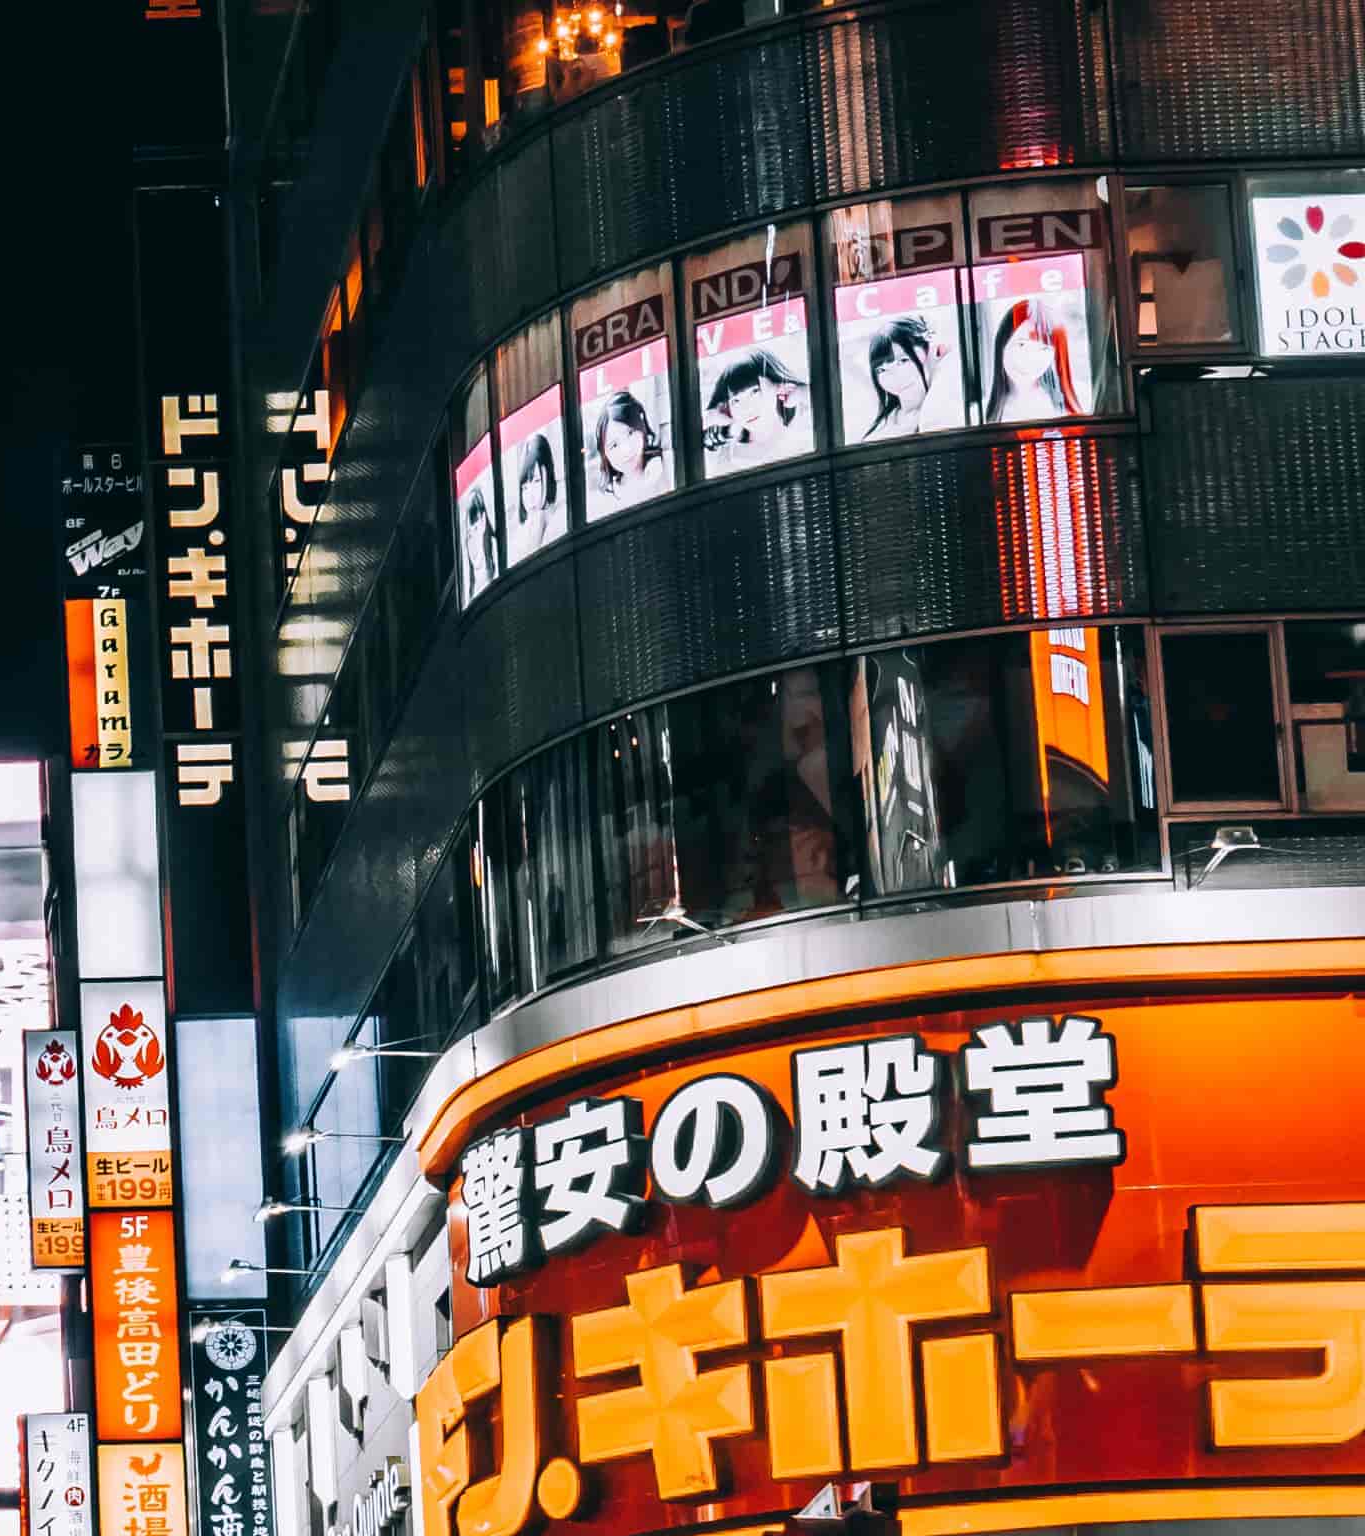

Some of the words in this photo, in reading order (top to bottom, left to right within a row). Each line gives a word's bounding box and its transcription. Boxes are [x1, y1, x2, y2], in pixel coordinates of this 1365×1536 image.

[1284, 306, 1365, 329] IDOL
[96, 585, 121, 599] 7F
[461, 1013, 1126, 1289] 驚安の殿堂
[95, 1157, 170, 1176] 生ビール
[119, 1215, 149, 1239] 5F
[112, 1244, 164, 1434] 豊後高田どり
[65, 1418, 87, 1434] 4F
